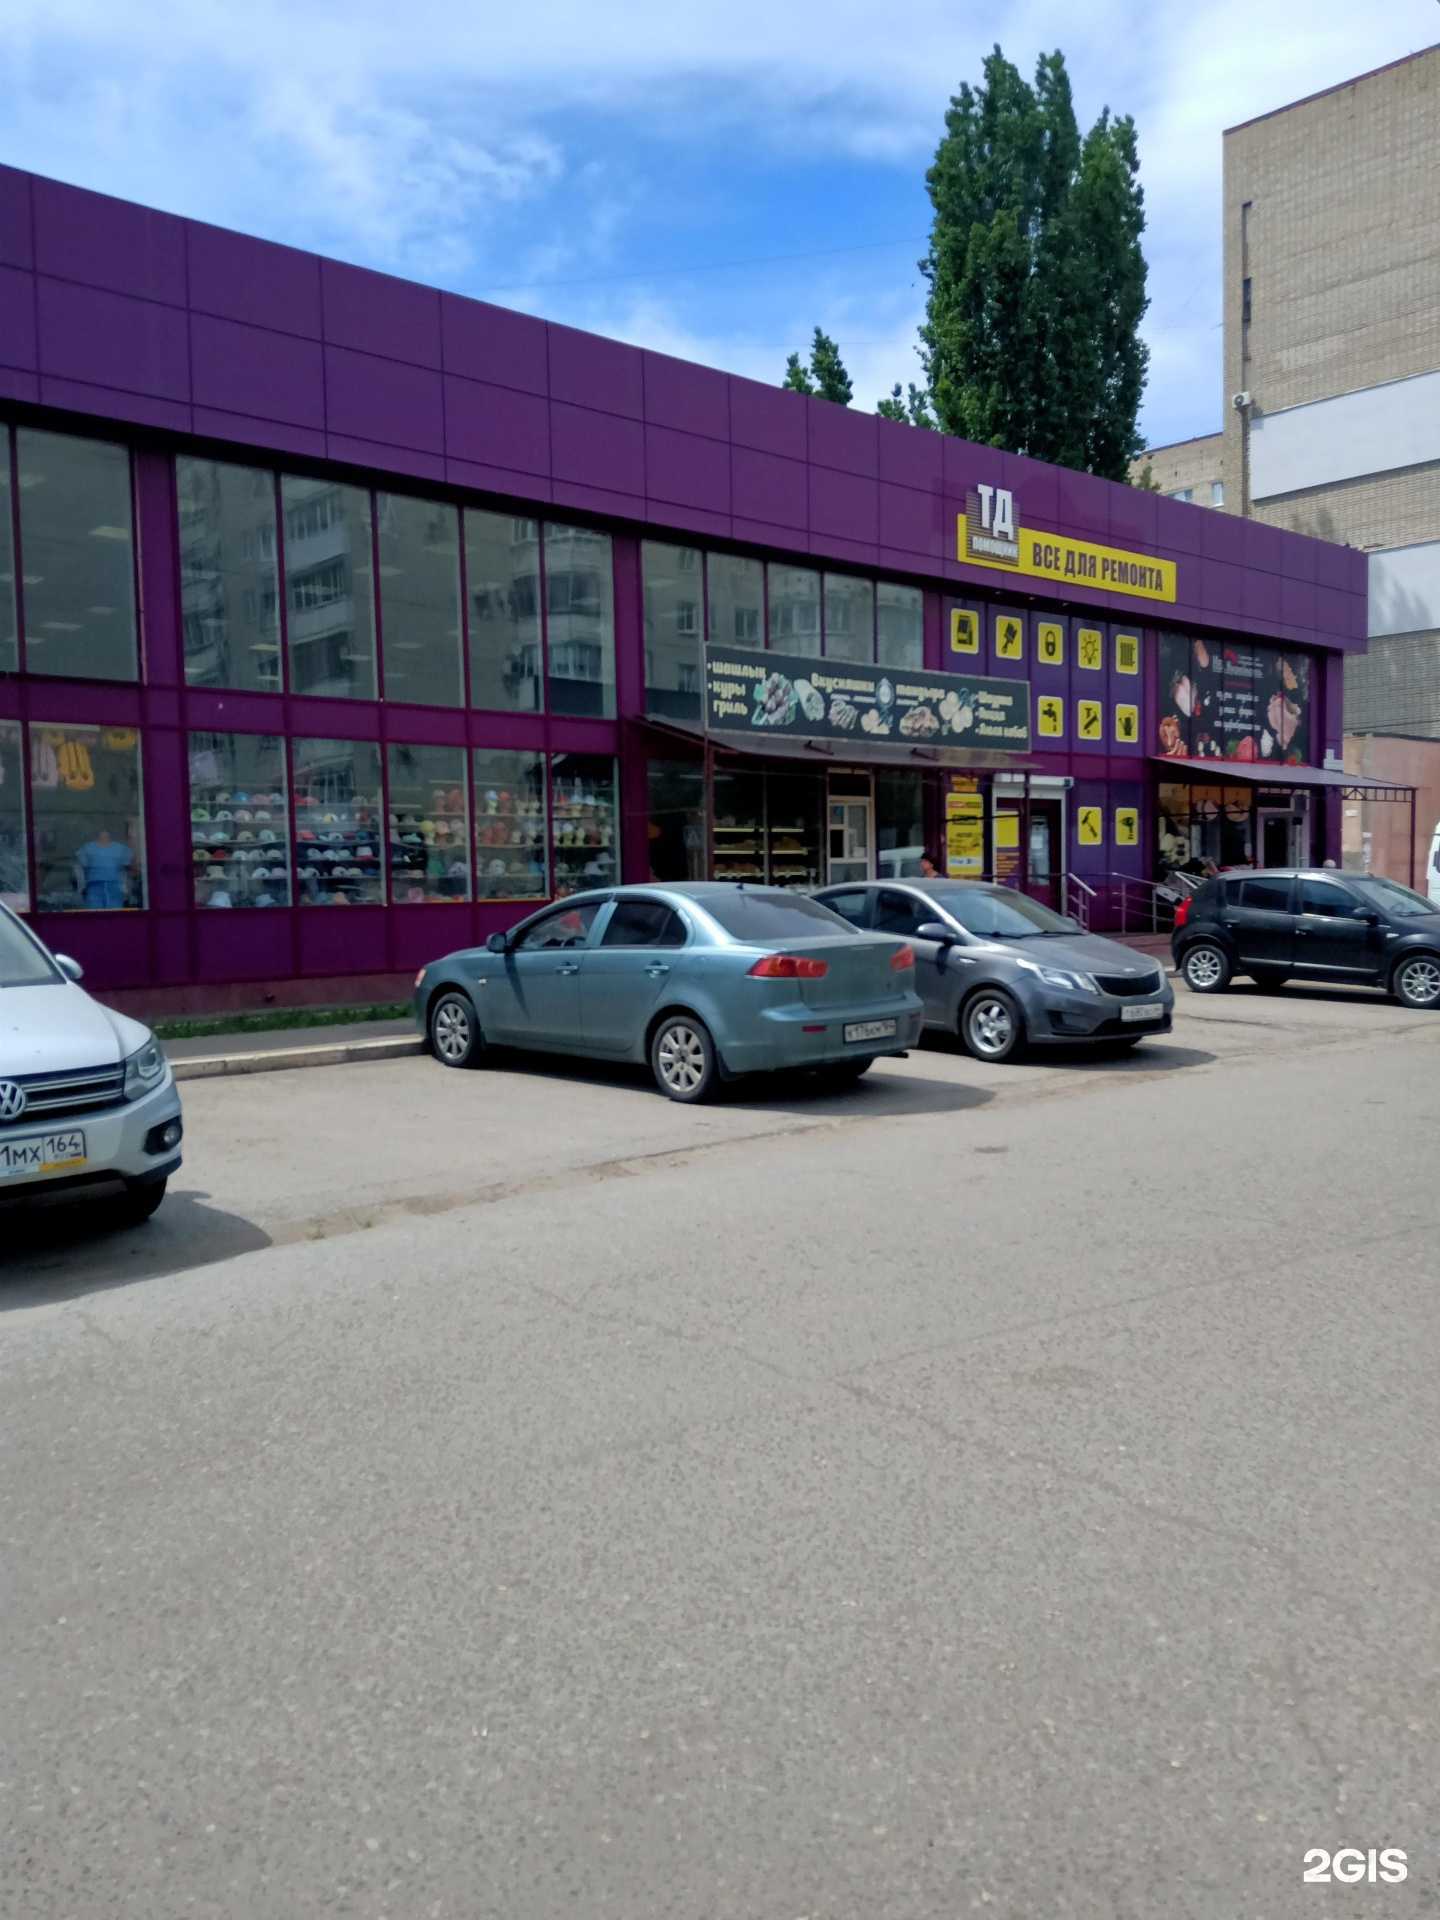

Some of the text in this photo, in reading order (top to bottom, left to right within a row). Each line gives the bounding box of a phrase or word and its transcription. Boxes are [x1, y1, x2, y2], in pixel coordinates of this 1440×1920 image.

[977, 484, 1015, 541] ТД
[1032, 542, 1061, 571] ВСЕ
[1064, 550, 1097, 578] ДЛЯ
[1101, 557, 1163, 592] РЕМОНТА
[46, 1134, 81, 1154] 164
